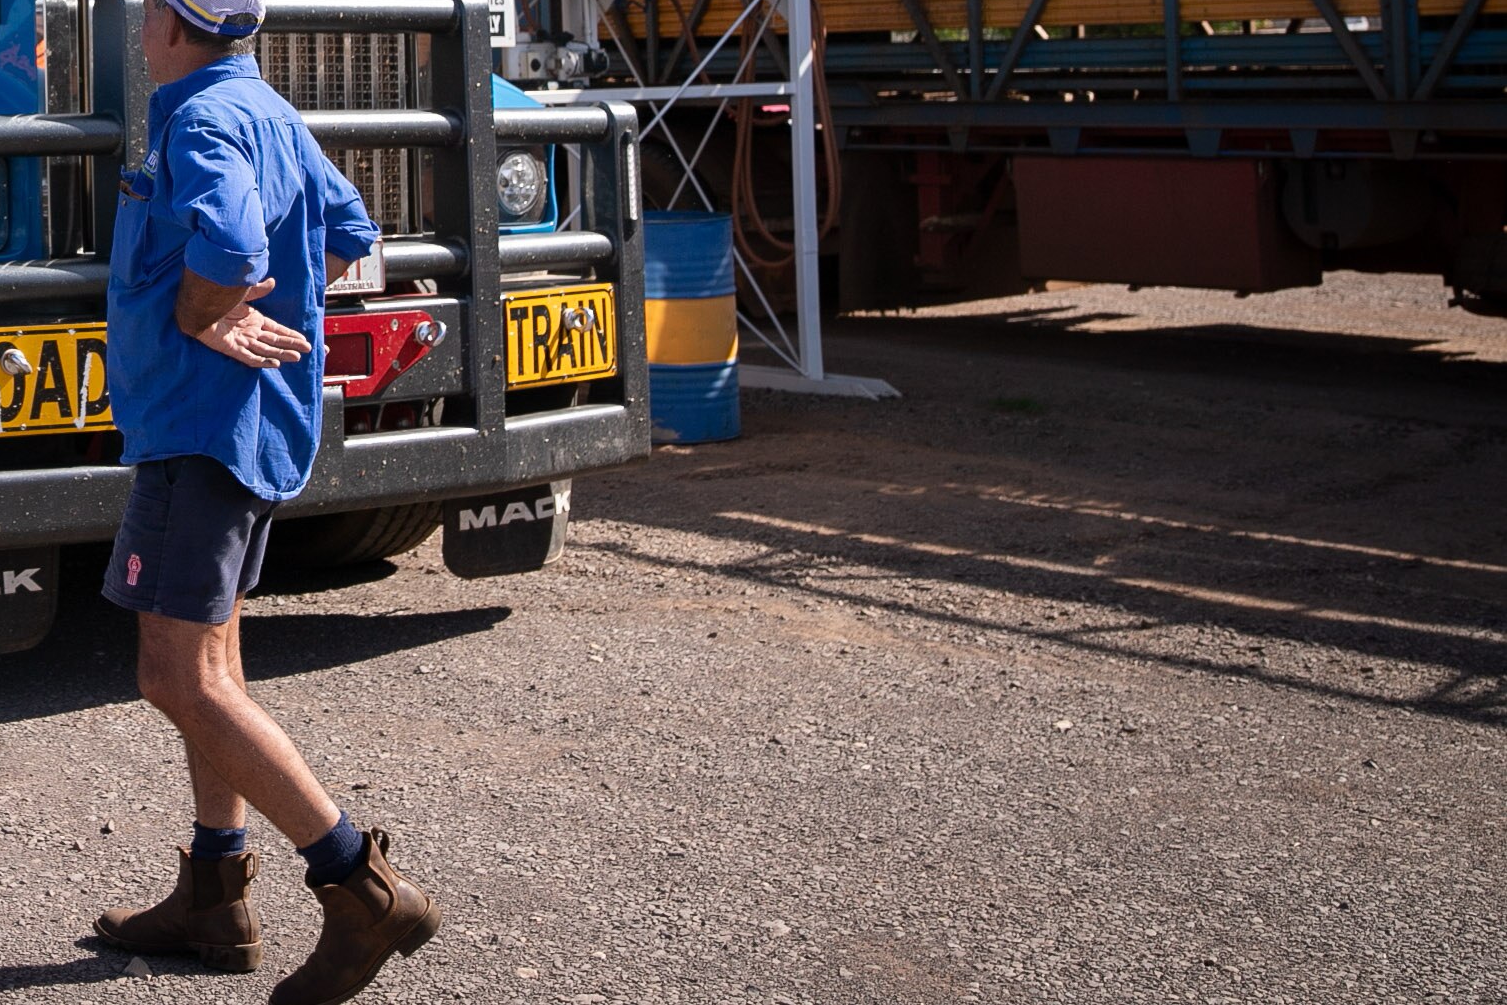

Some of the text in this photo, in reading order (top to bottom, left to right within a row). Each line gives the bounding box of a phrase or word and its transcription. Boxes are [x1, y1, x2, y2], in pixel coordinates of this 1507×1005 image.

[333, 281, 374, 291] AUSTRALIA
[509, 298, 608, 376] TRAIN
[458, 490, 571, 531] MACK
